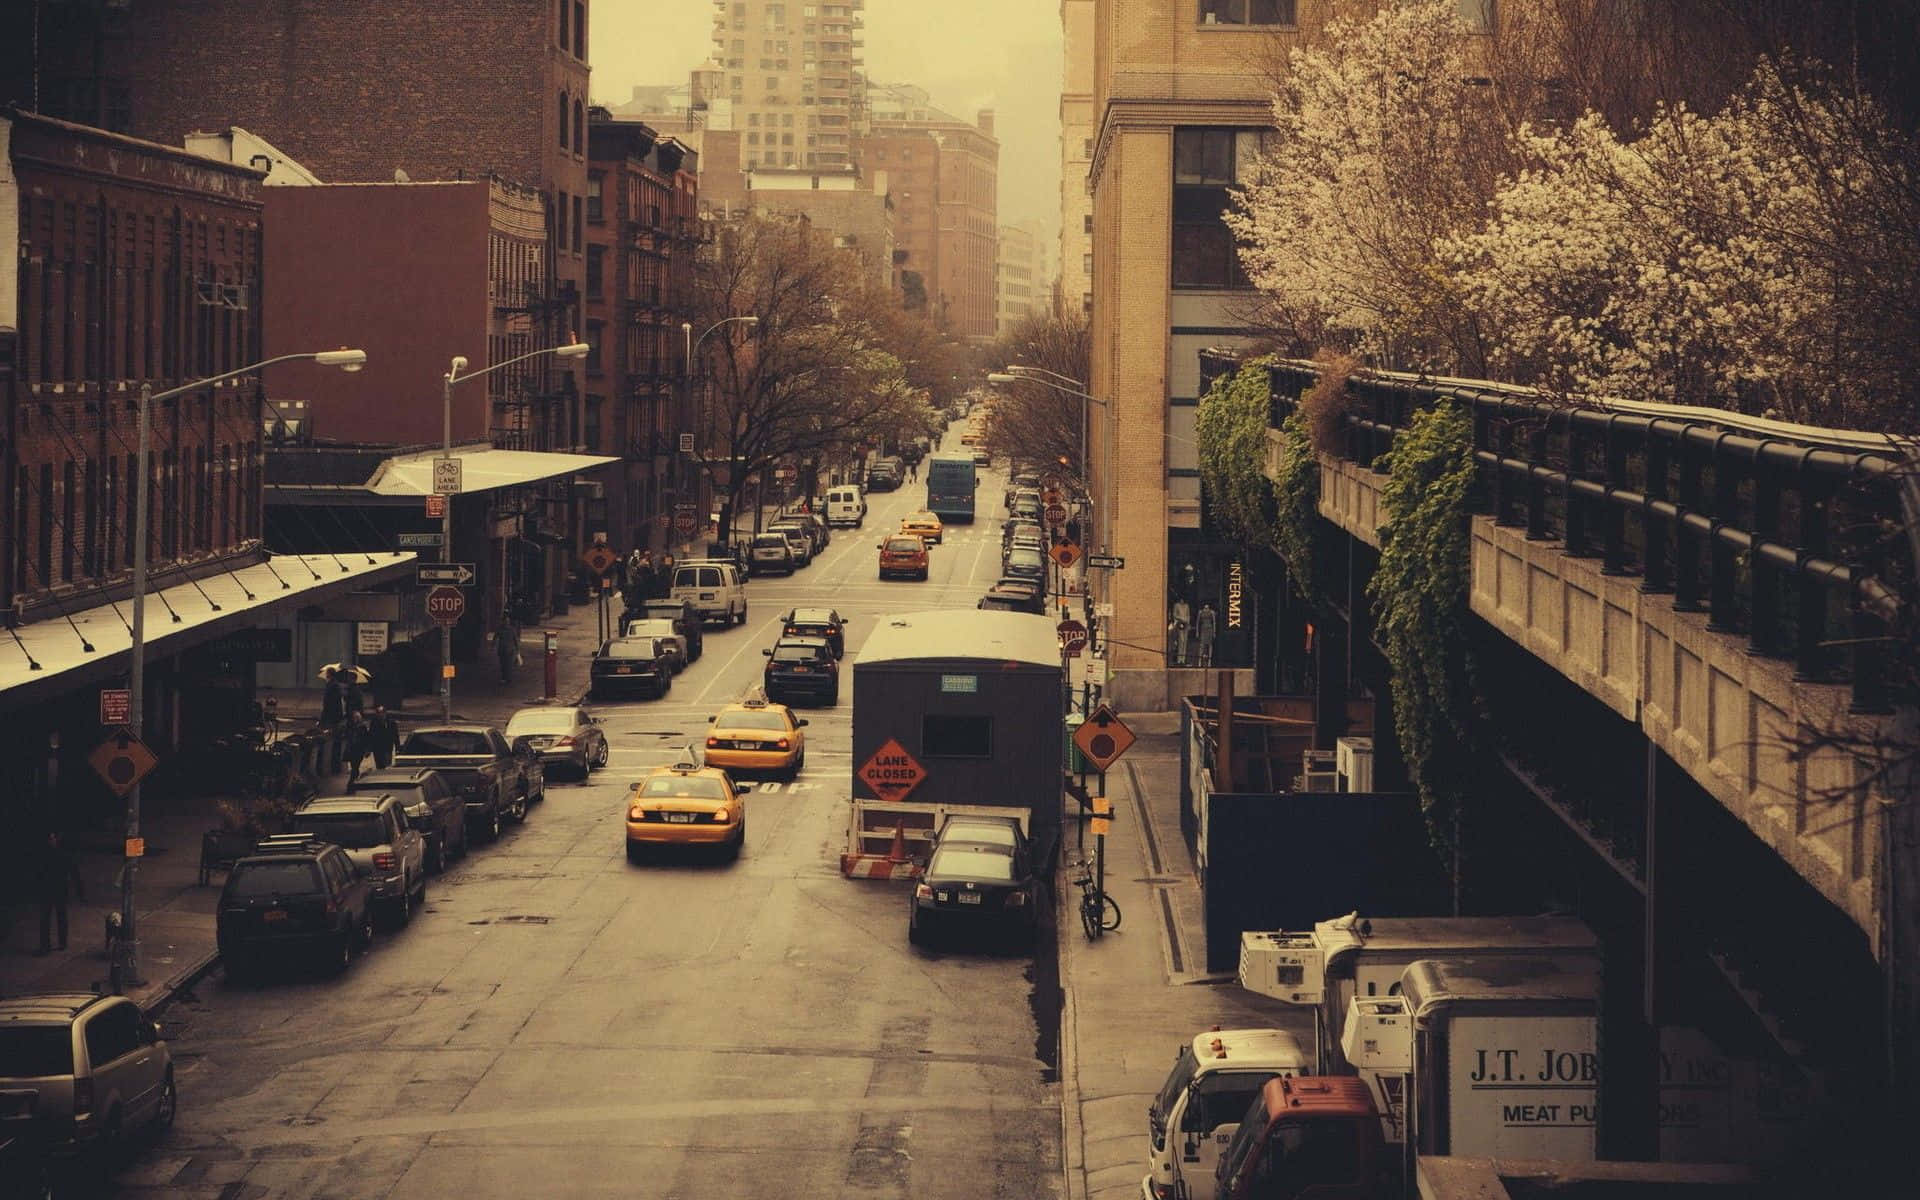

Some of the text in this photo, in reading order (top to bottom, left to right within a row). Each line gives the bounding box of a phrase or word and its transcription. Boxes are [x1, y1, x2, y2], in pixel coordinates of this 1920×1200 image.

[1047, 510, 1065, 519] STOP
[678, 518, 695, 528] STOP
[1228, 562, 1241, 628] INTERMIX
[431, 598, 462, 612] STOP
[1058, 630, 1085, 641] STOP
[875, 755, 909, 767] LANE
[867, 768, 916, 779] CLOSED
[736, 781, 823, 795] TOP
[1471, 1049, 1525, 1081] J.T.
[1503, 1105, 1561, 1122] MEAT
